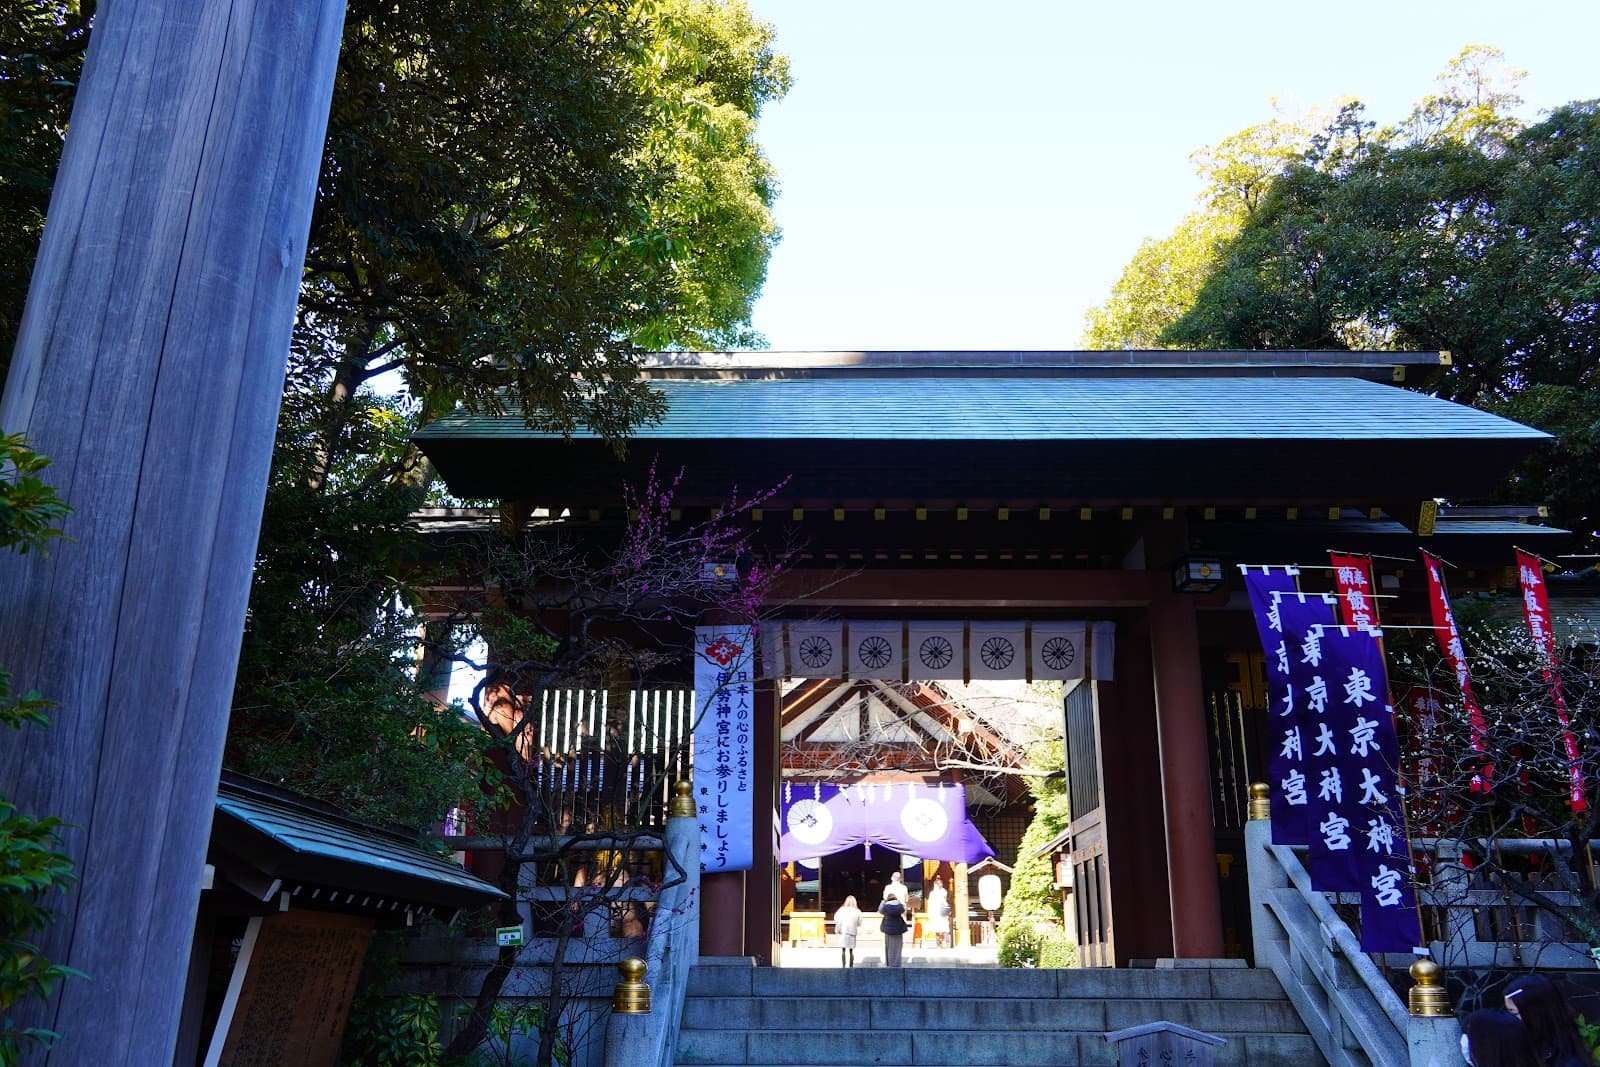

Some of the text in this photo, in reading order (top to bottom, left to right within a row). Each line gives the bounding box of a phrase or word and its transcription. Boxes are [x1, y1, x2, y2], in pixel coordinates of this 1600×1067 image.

[715, 671, 732, 868] 伊勢神宮にお参りしましょう
[736, 671, 749, 792] 日本人の心のふるさと
[1300, 630, 1352, 851] 東京大神宮
[1343, 667, 1403, 908] 東京大神宮
